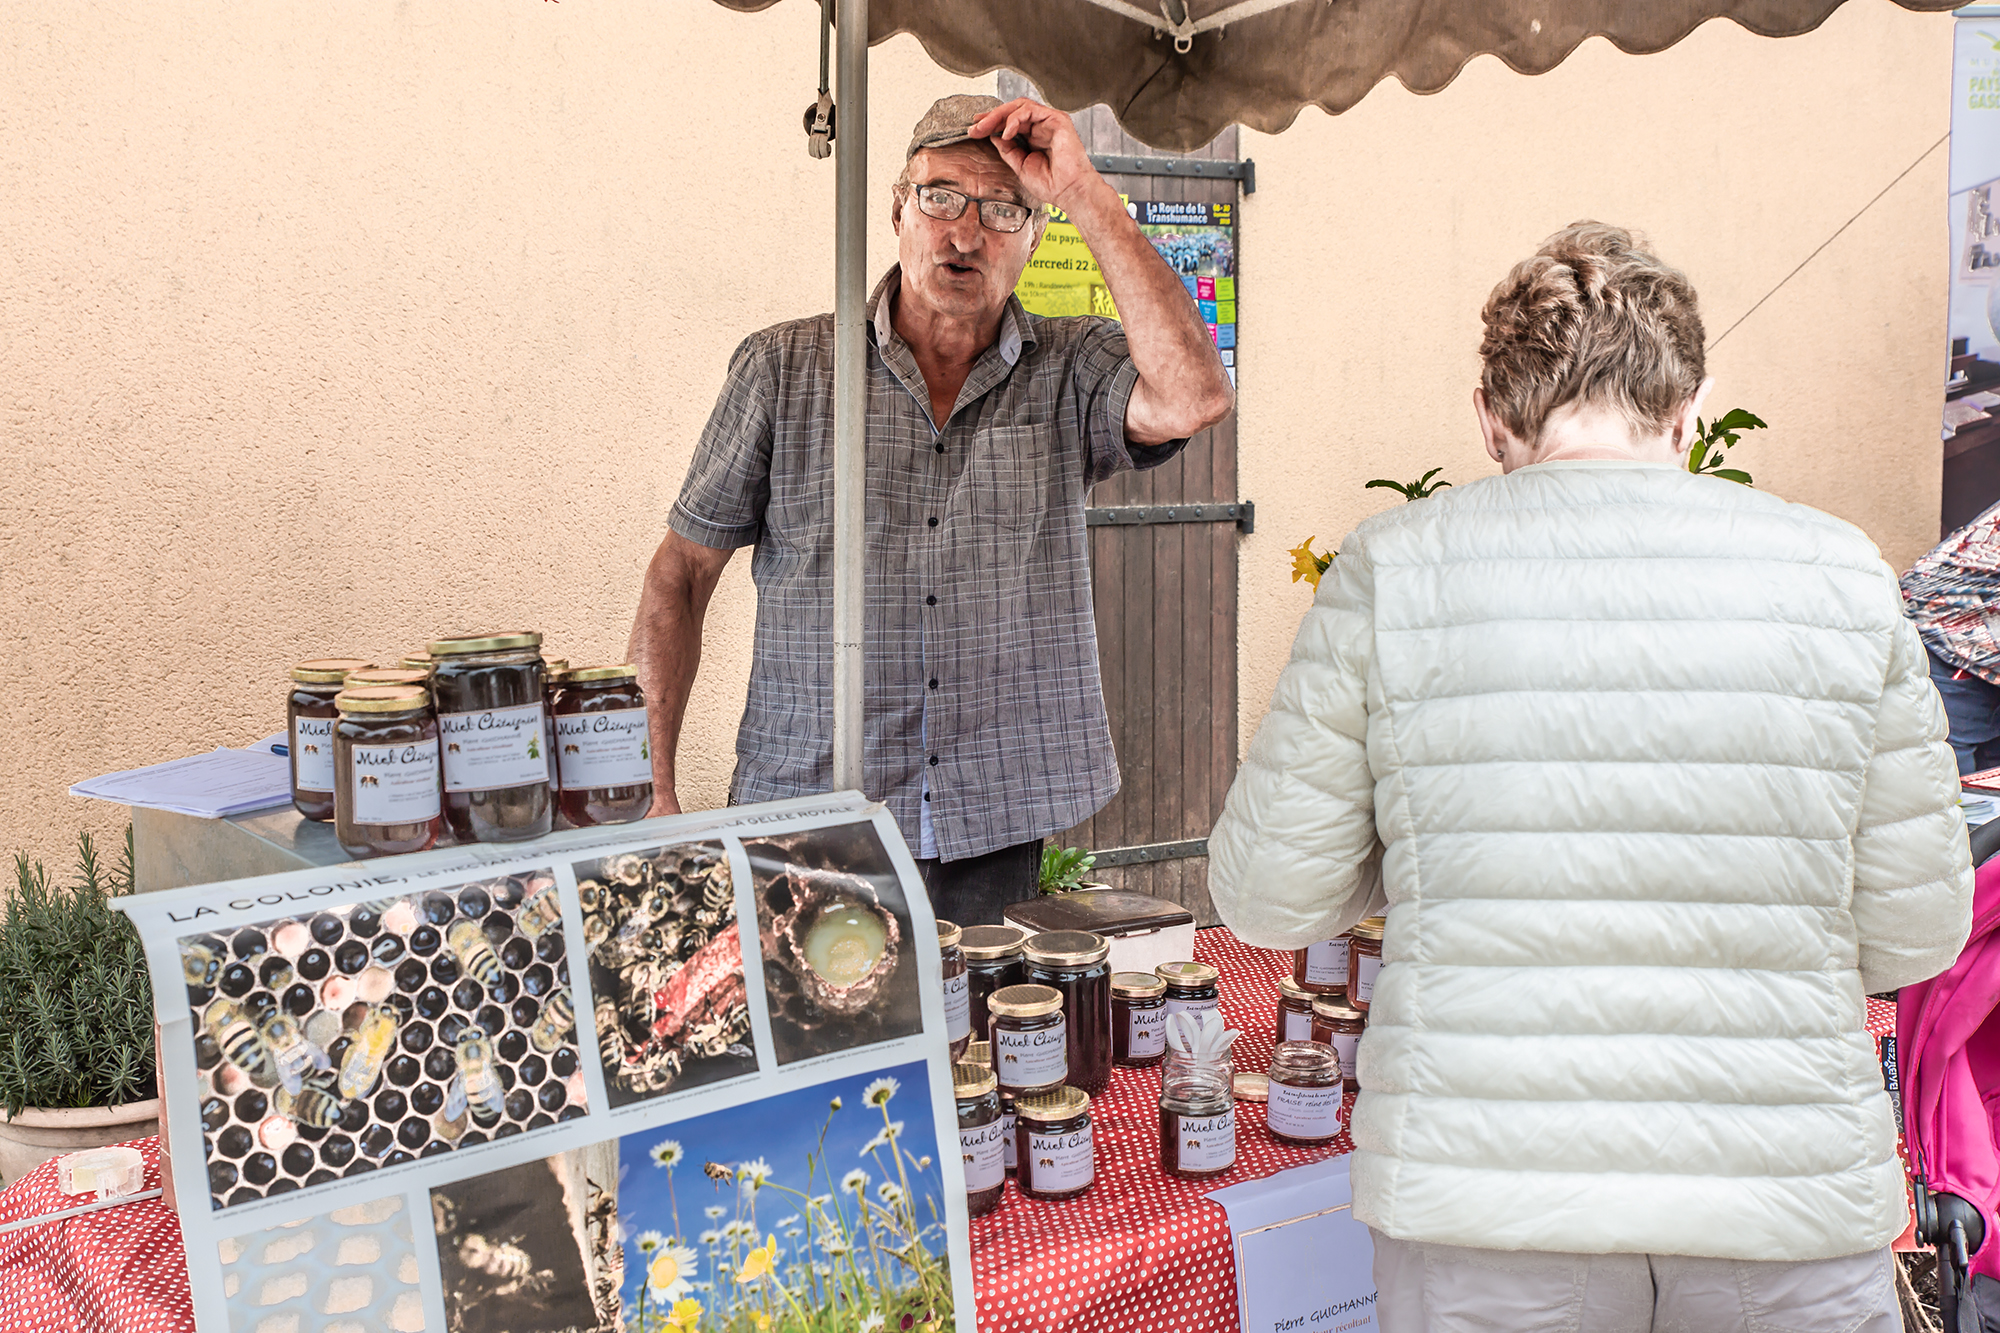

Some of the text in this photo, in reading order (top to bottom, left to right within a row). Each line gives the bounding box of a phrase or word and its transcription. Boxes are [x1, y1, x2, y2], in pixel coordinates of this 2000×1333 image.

[1146, 202, 1207, 215] La Route de la
[1147, 213, 1208, 224] Transhumance
[1046, 232, 1057, 241] du
[1076, 261, 1089, 271] 22
[442, 716, 474, 734] Miel
[558, 718, 589, 736] Miel
[356, 749, 397, 766] Miel
[167, 905, 219, 922] LA
[228, 875, 409, 910] COLONIE,
[725, 819, 745, 828] LA
[747, 811, 796, 825] GELÉE
[799, 806, 856, 819] ROYALE
[1134, 1010, 1160, 1025] Miel
[999, 1033, 1031, 1048] Miel
[1884, 1039, 1899, 1090] BABYZEN
[1277, 1095, 1303, 1106] FRAISE
[1182, 1119, 1214, 1133] Miel
[1033, 1138, 1065, 1151] Miel
[1274, 1316, 1304, 1333] Pierre
[1335, 1315, 1371, 1333] récoltant
